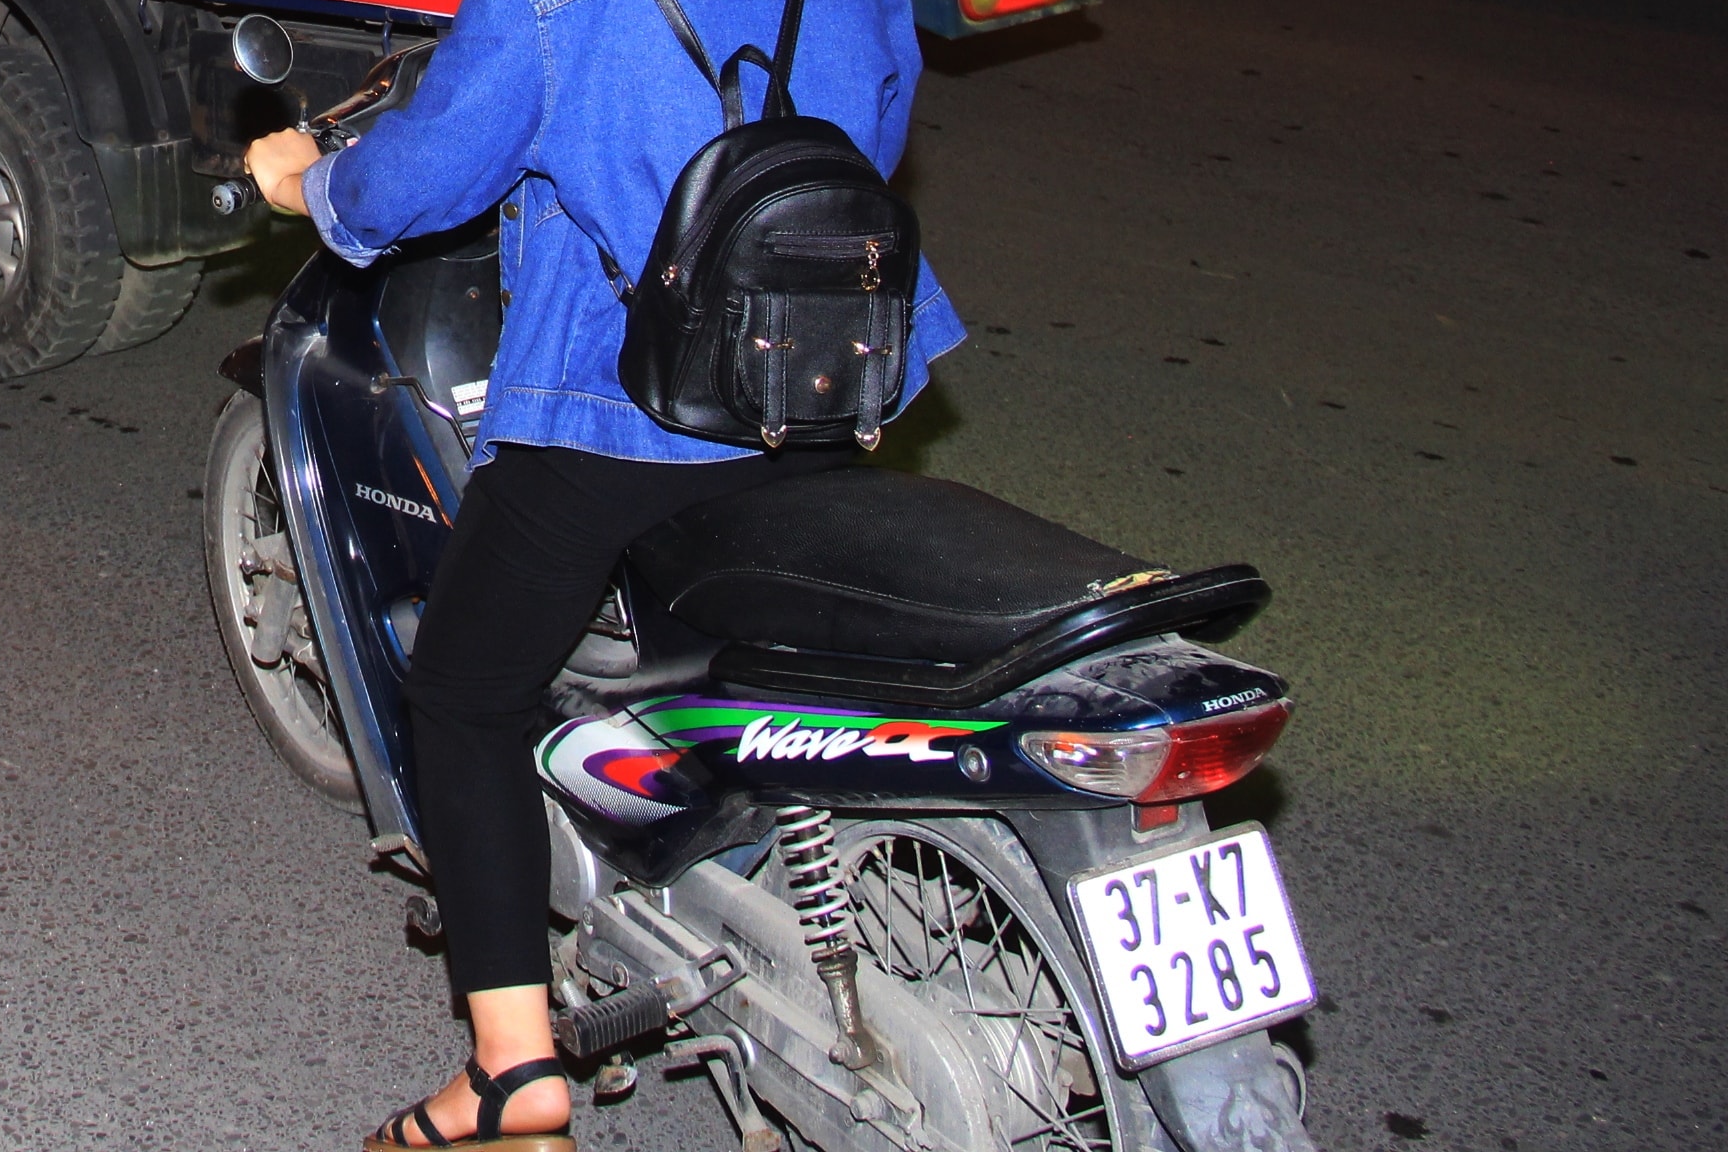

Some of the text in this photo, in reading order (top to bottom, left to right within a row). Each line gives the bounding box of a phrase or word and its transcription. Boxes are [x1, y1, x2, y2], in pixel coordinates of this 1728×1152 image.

[355, 483, 438, 524] HONDA
[1201, 687, 1268, 712] HONDA
[1104, 841, 1247, 952] 37-K7
[1130, 924, 1282, 1037] 3285
